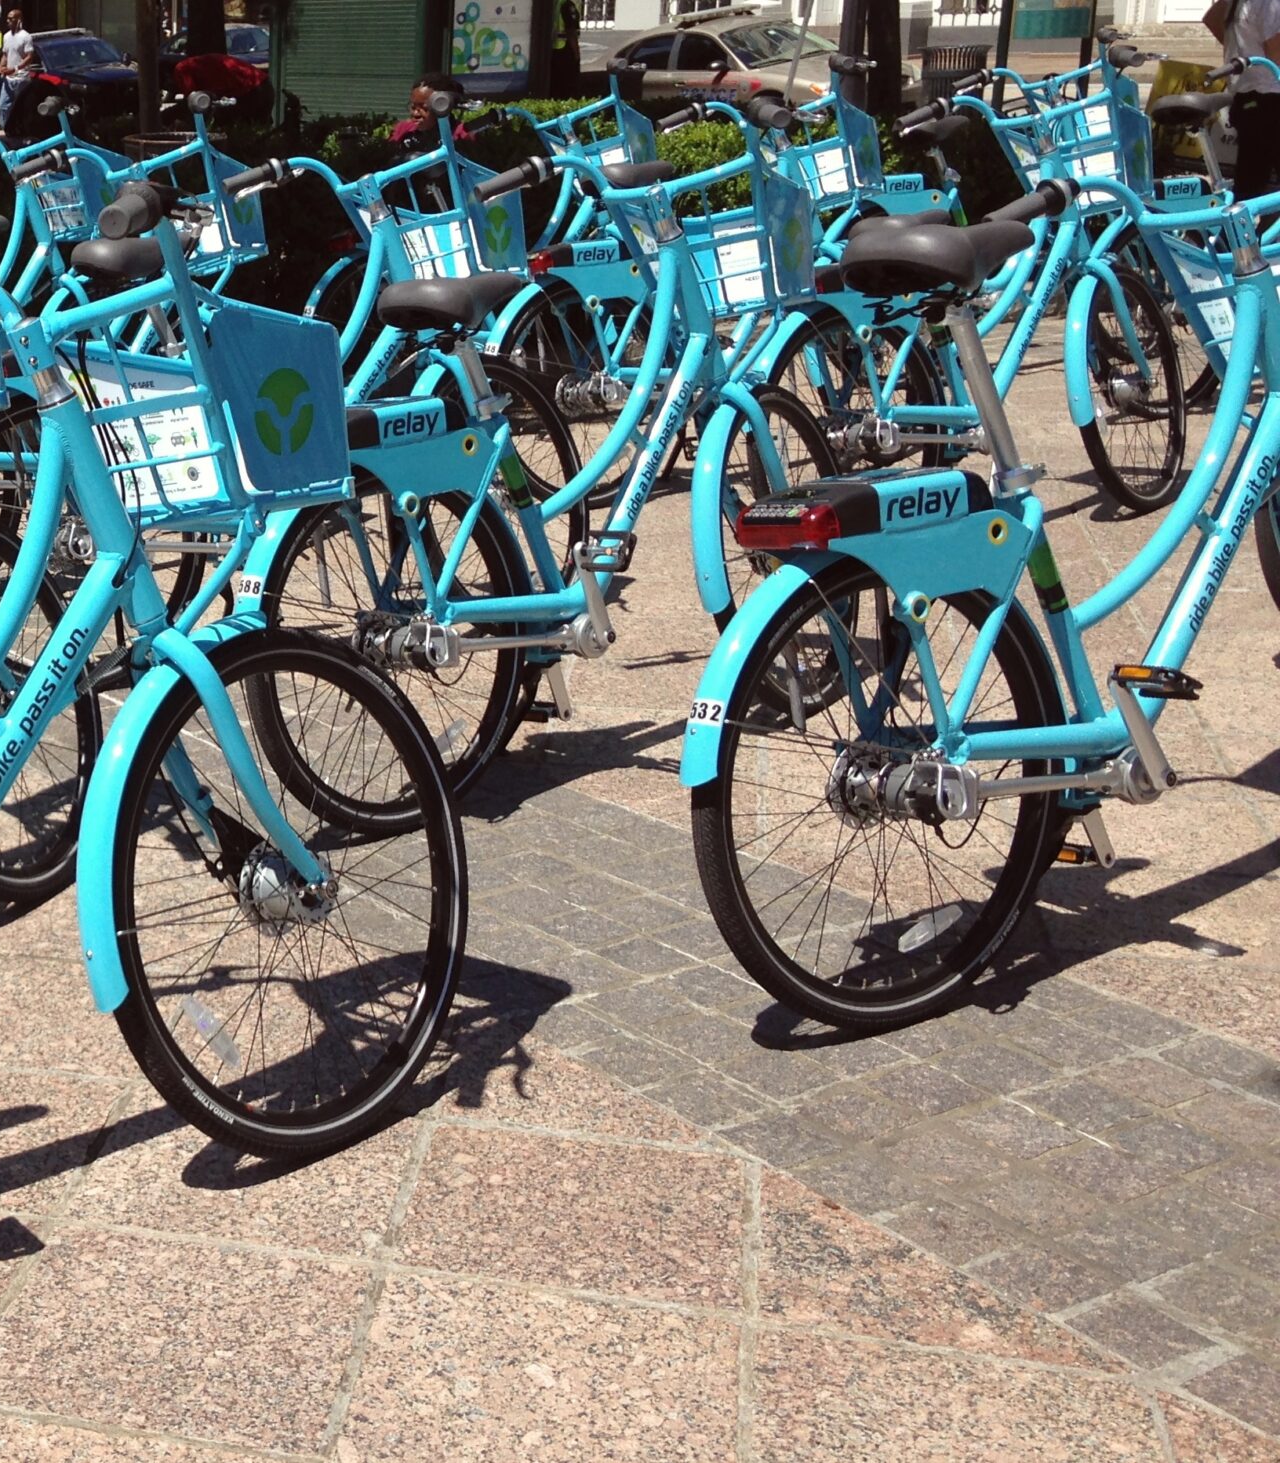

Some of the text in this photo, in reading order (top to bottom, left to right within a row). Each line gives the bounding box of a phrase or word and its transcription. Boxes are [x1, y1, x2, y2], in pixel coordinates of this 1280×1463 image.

[889, 179, 921, 192] relay
[1167, 182, 1198, 195] relay
[577, 247, 616, 263] relay
[358, 369, 378, 400] pass
[374, 359, 383, 369] it
[384, 411, 440, 439] relay
[626, 492, 643, 520] ride
[638, 481, 647, 491] a
[658, 412, 676, 448] pass
[670, 400, 682, 412] it
[886, 487, 961, 522] relay
[1188, 455, 1274, 631] ride a bike. pass it on.
[238, 579, 261, 595] 588
[19, 678, 55, 736] pass
[47, 658, 67, 679] it
[62, 628, 88, 658] on.
[690, 702, 722, 722] 532
